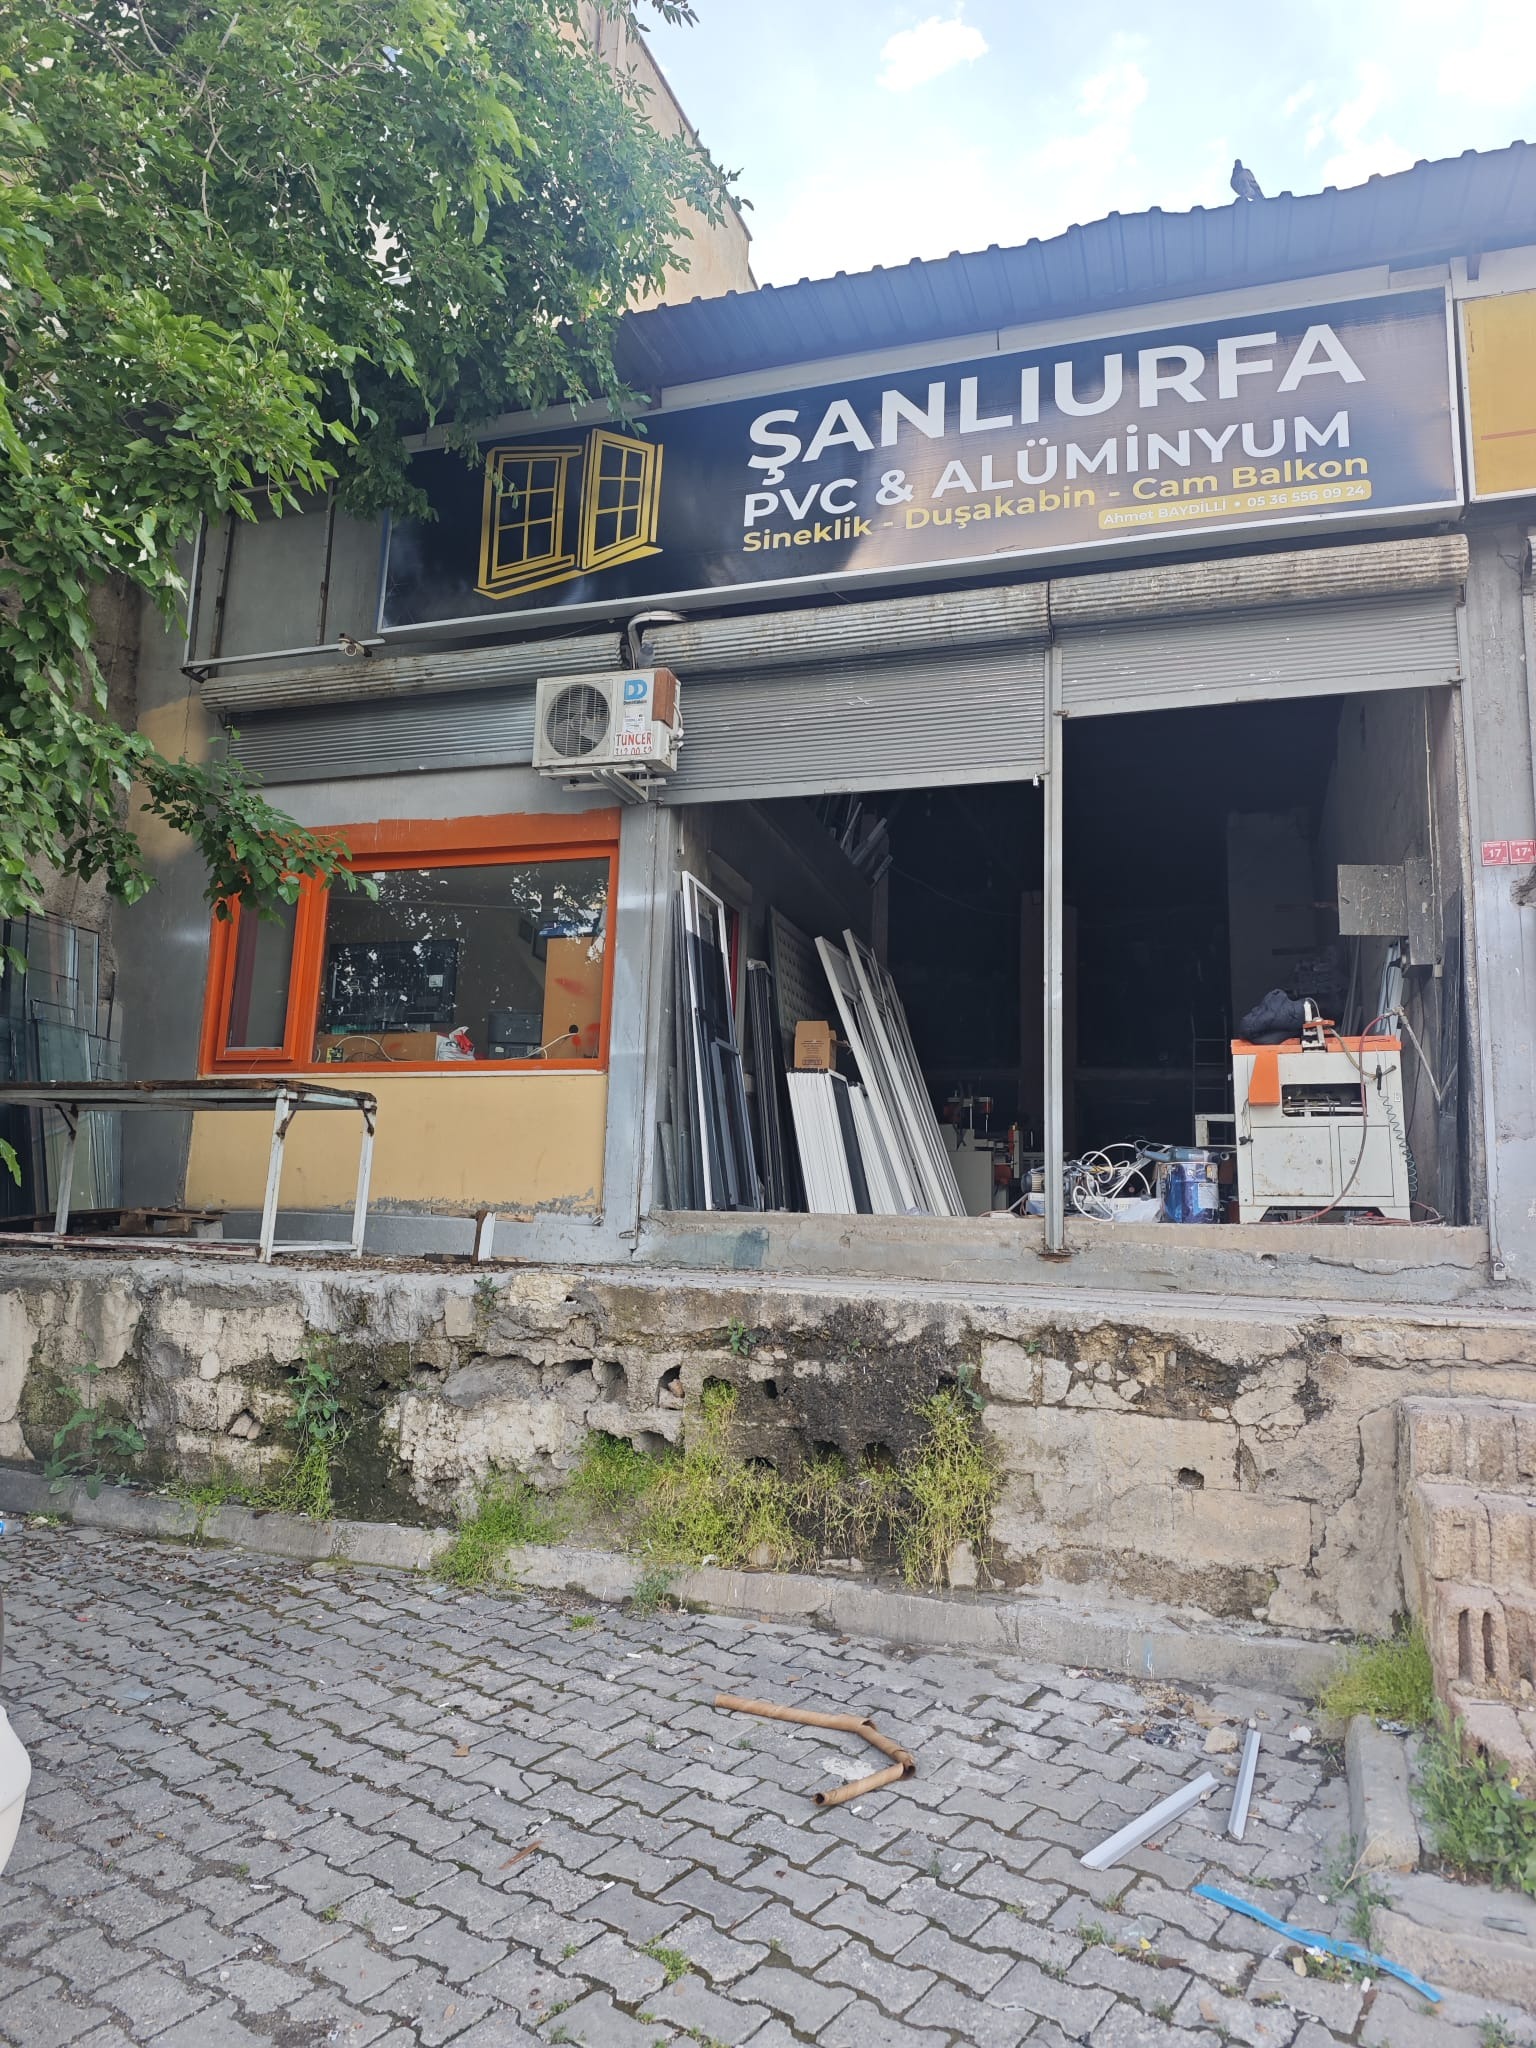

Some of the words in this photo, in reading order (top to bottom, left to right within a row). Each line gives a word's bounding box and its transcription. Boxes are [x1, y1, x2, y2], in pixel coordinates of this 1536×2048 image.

[748, 324, 1366, 485] ŞANLIURFA
[743, 478, 857, 527] PVC
[875, 469, 914, 506] &
[931, 411, 1350, 498] ALÜMİNYUM
[743, 516, 872, 552] Sineklik
[905, 486, 1095, 529] Duşakabin
[1132, 475, 1218, 500] Cam
[1232, 456, 1369, 490] Balkon
[1103, 508, 1154, 525] Ahmet
[1247, 496, 1266, 508] 05
[1269, 493, 1288, 505] 36
[1322, 487, 1342, 499] 09
[1346, 485, 1365, 497] 24
[1489, 849, 1501, 857] 17
